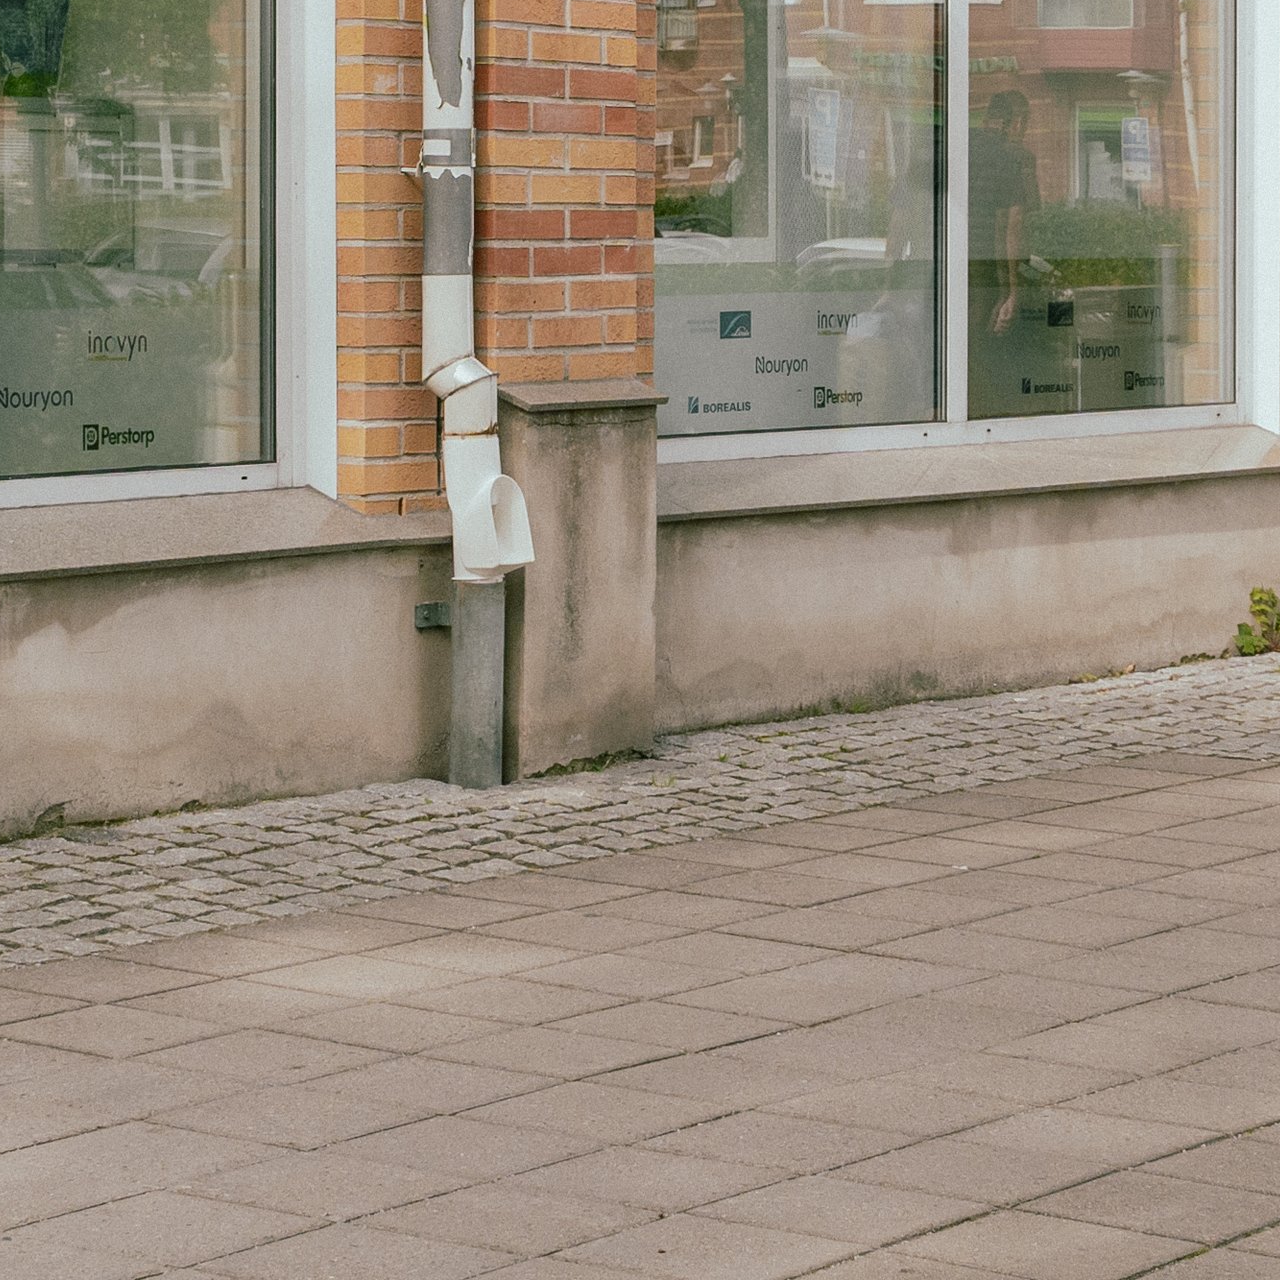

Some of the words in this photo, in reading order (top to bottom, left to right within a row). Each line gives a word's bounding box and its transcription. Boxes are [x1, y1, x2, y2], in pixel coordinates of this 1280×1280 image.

[87, 330, 148, 361] inovyn
[1077, 343, 1120, 361] Nouryon
[755, 356, 808, 376] Nouryon
[703, 401, 751, 414] BOREALIS
[826, 388, 863, 408] Perstorp
[101, 426, 155, 448] Perstorp
